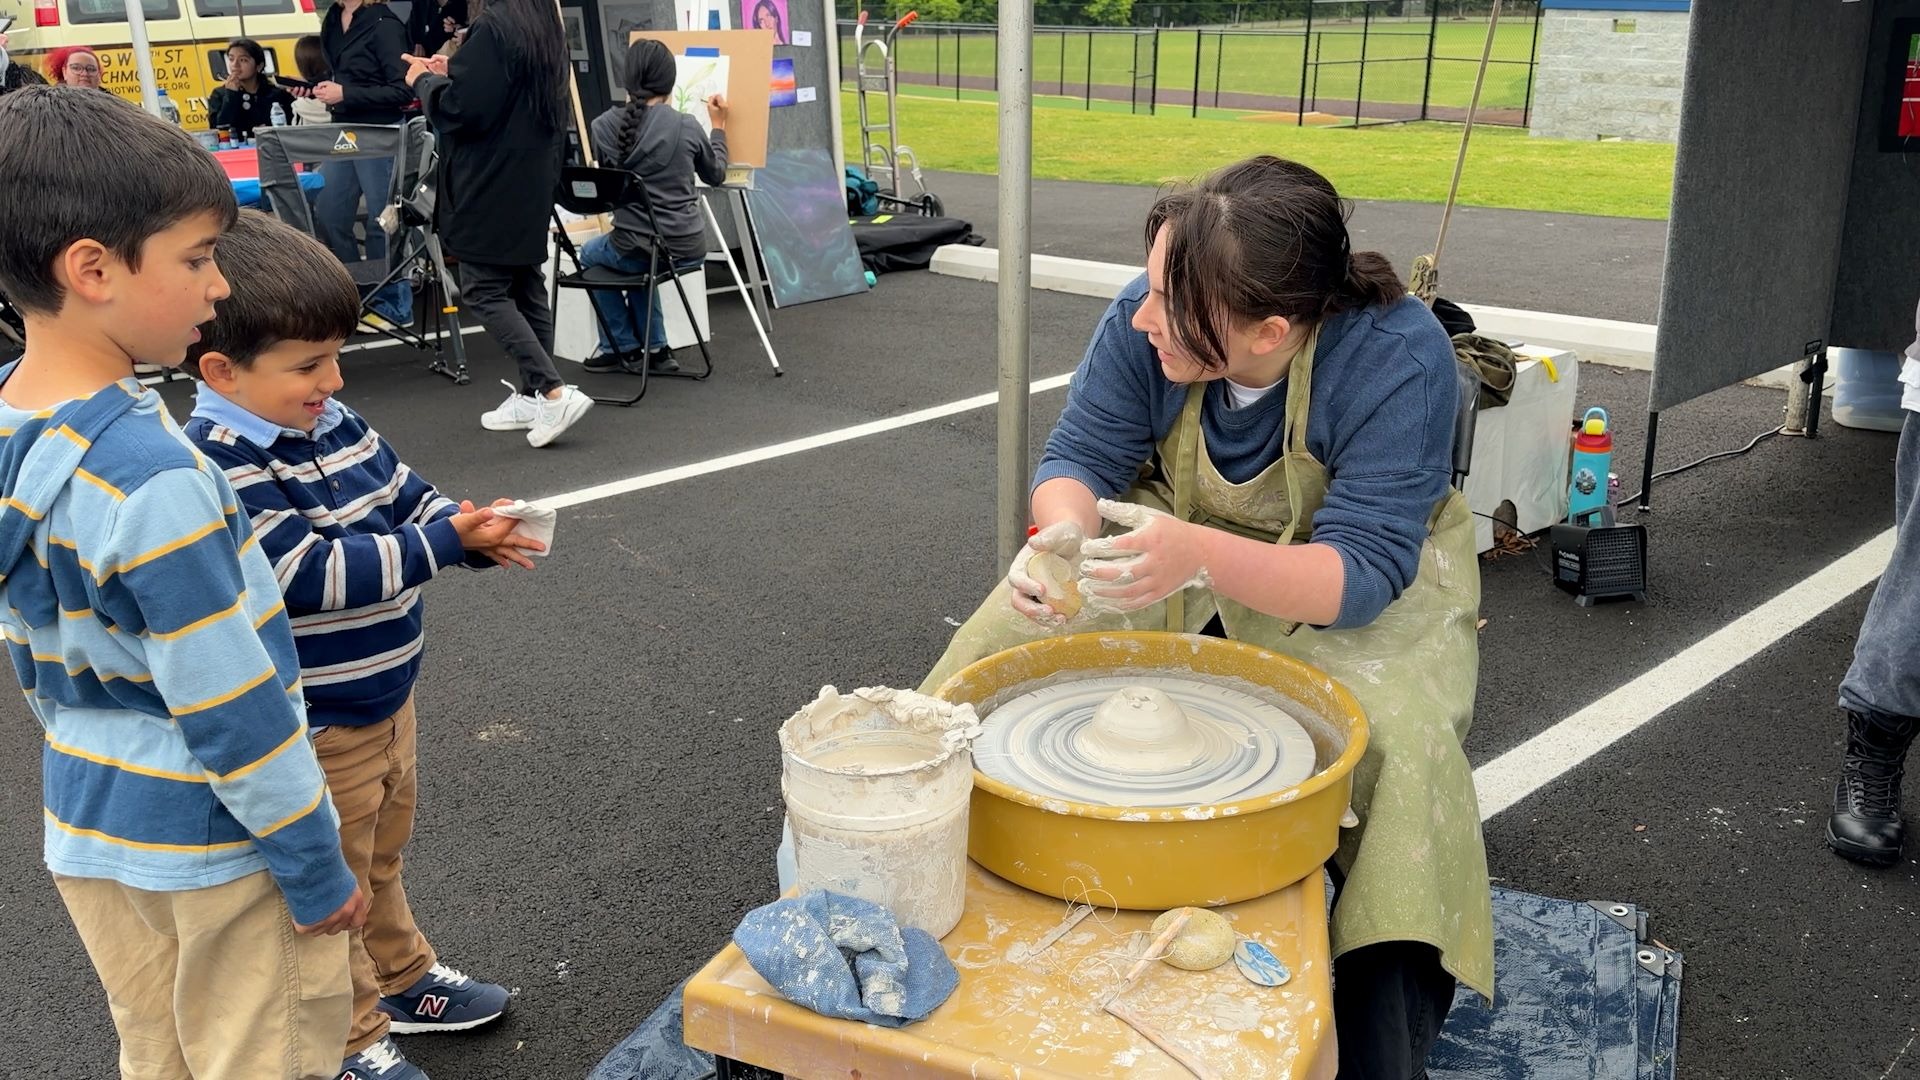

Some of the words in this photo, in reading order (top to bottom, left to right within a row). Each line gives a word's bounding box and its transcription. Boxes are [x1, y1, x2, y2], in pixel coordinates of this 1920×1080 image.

[117, 52, 132, 66] W
[164, 49, 183, 64] ST
[172, 66, 189, 78] VA
[415, 993, 449, 1018] N
